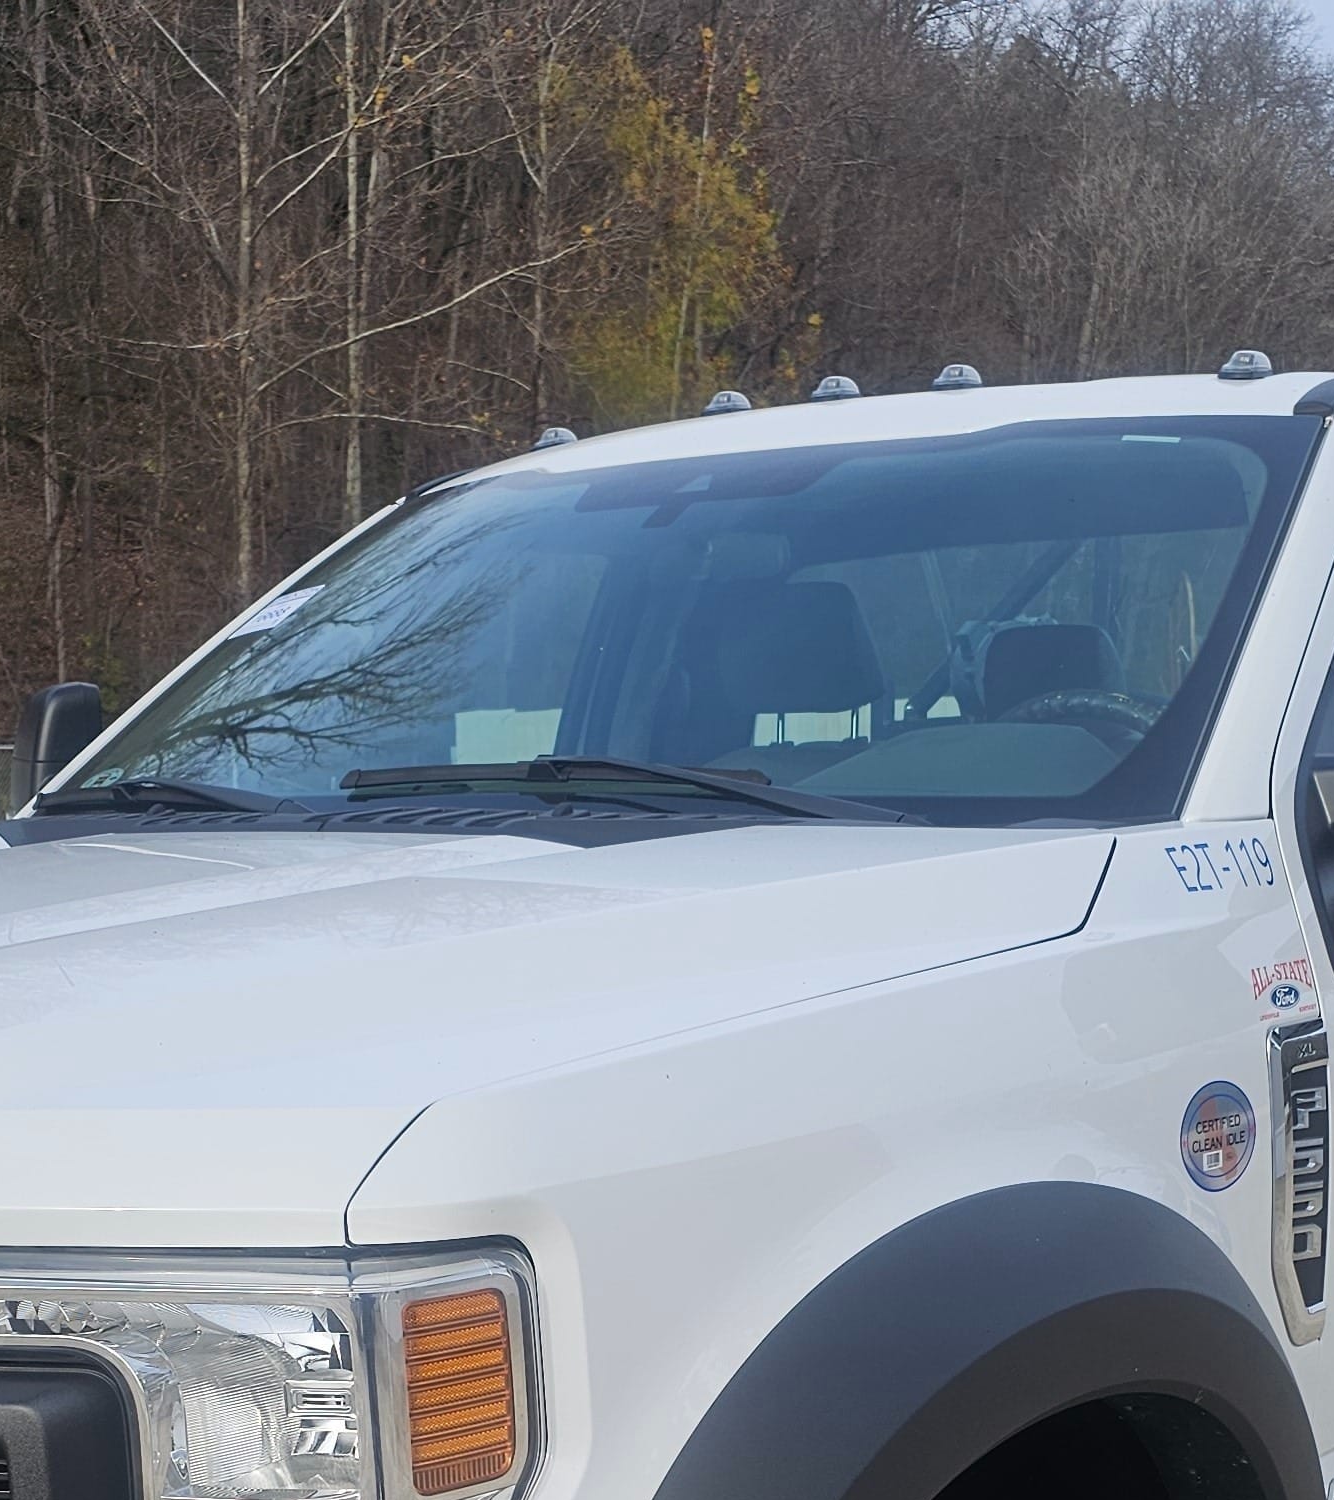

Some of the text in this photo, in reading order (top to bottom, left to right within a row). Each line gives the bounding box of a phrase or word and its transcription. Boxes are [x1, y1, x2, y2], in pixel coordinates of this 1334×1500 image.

[1165, 837, 1274, 893] E2T-119
[1275, 986, 1297, 1006] Ford
[1297, 1042, 1317, 1059] XL
[1195, 1114, 1241, 1135] CERTIFIED
[1192, 1130, 1246, 1154] CLEAN IDLE
